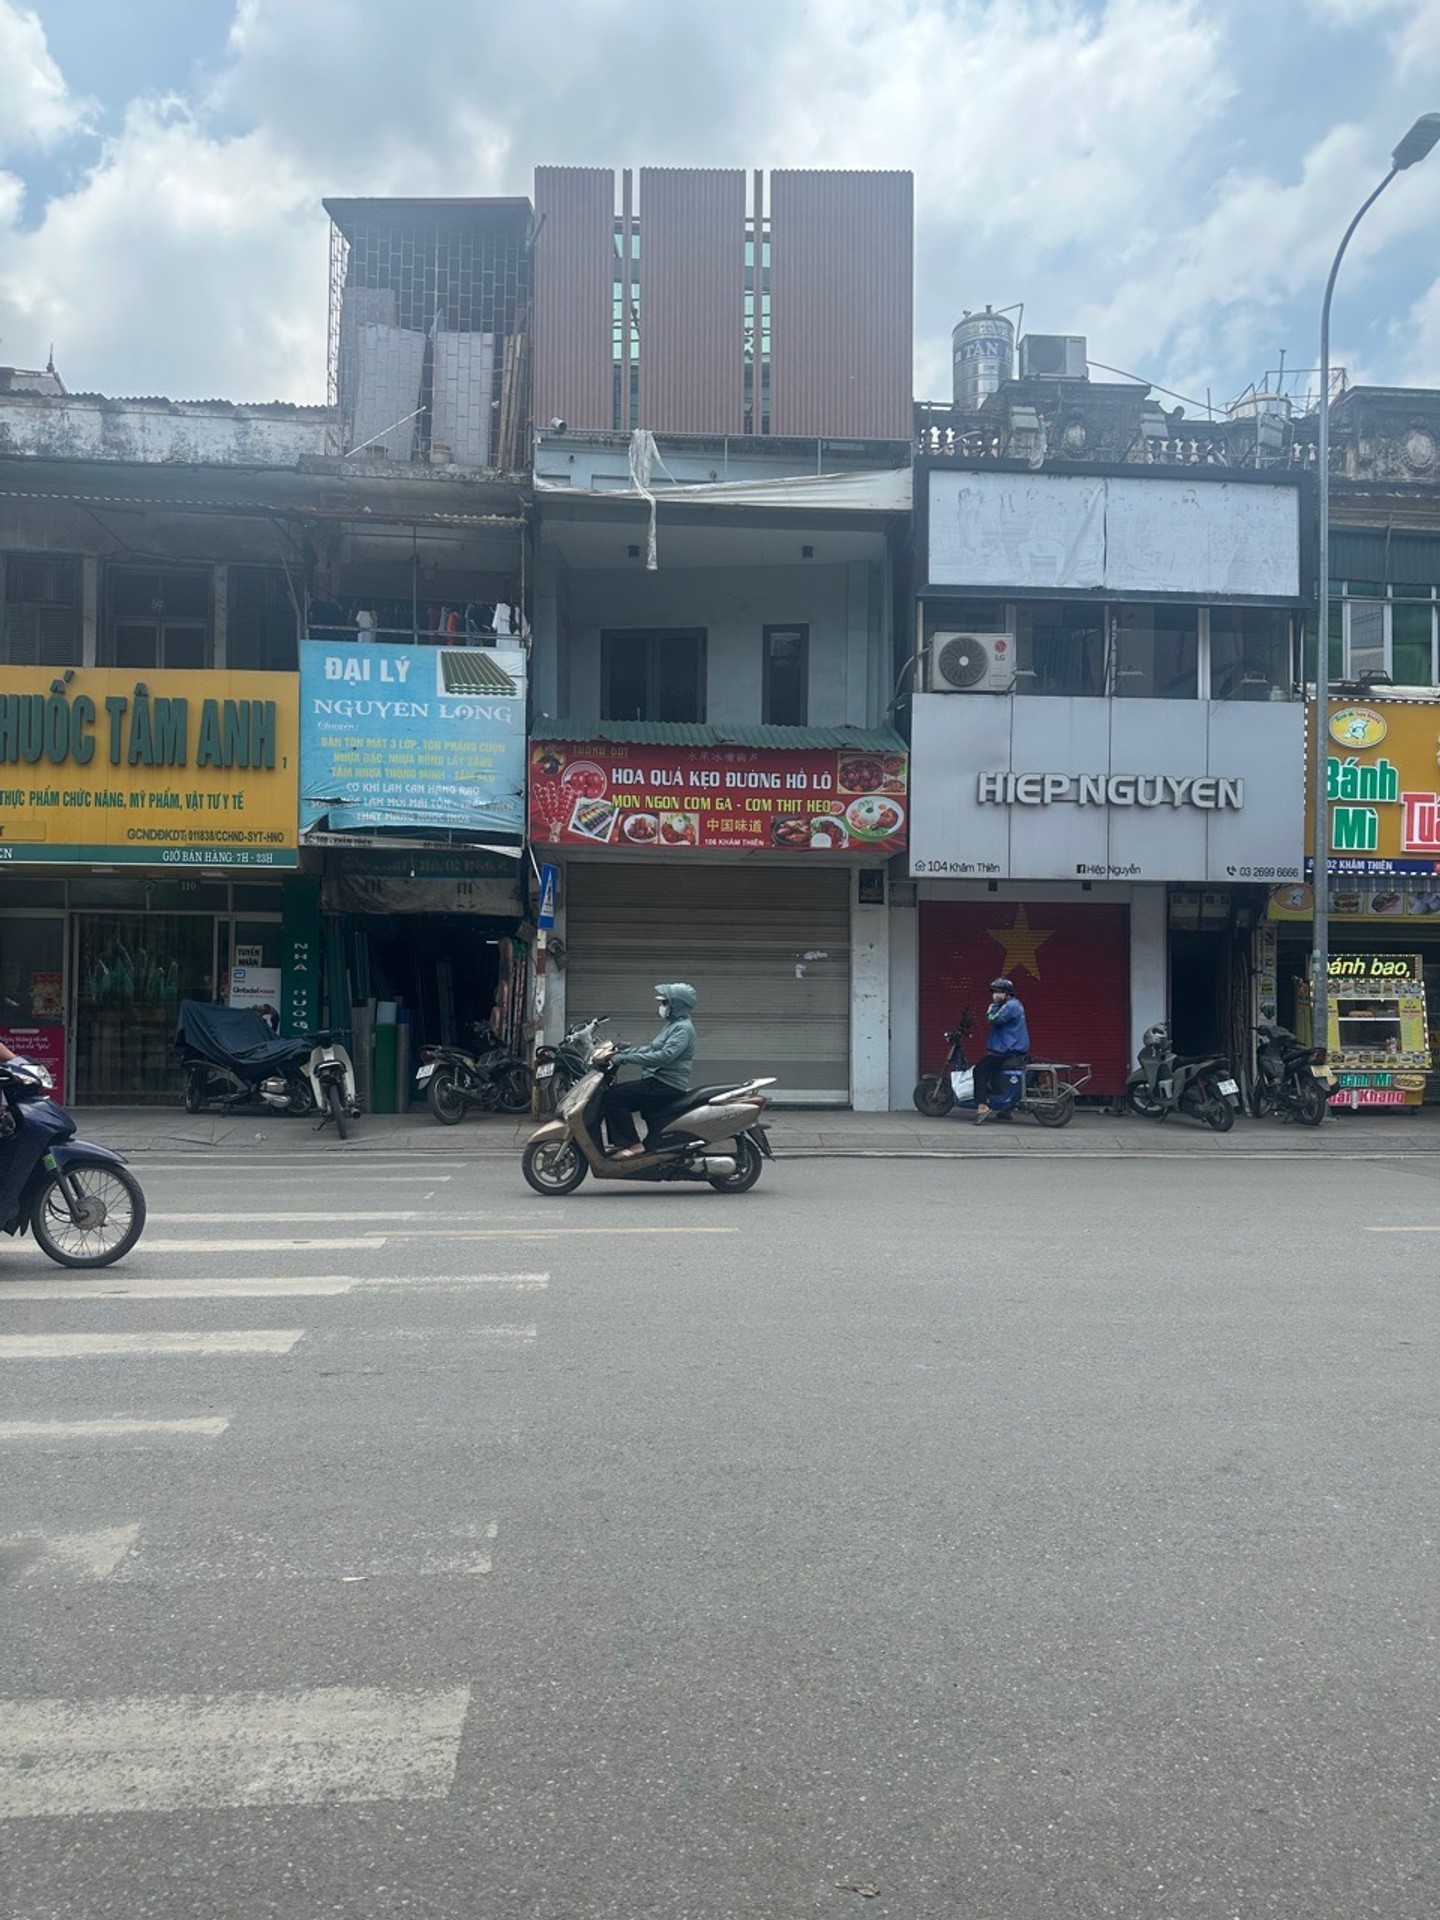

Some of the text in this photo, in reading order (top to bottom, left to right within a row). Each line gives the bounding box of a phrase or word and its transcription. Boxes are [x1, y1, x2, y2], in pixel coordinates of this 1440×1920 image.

[324, 655, 411, 686] ĐẠI LÝ
[105, 682, 188, 767] TÂM
[197, 698, 276, 769] ANH
[611, 767, 645, 785] HOA
[650, 766, 684, 786] QUẢ
[689, 770, 721, 790] KẸO
[813, 770, 832, 790] LÔ
[29, 785, 59, 807] PHẨM
[63, 787, 91, 807] CHỨC
[130, 790, 146, 808] MỸ
[186, 790, 204, 811] VẬT
[222, 794, 230, 810] Y
[232, 790, 244, 810] TẾ
[976, 771, 1245, 810] HIEP NGUYEN
[645, 795, 680, 810] NGON
[806, 799, 831, 813] HEO
[706, 818, 762, 834] 中国味道
[1332, 806, 1378, 850] Mì
[182, 848, 203, 862] BÁN
[1367, 860, 1394, 871] THIÊN
[928, 860, 1000, 874] 104 Khâm Thiên
[1326, 957, 1411, 977] ánh bao,
